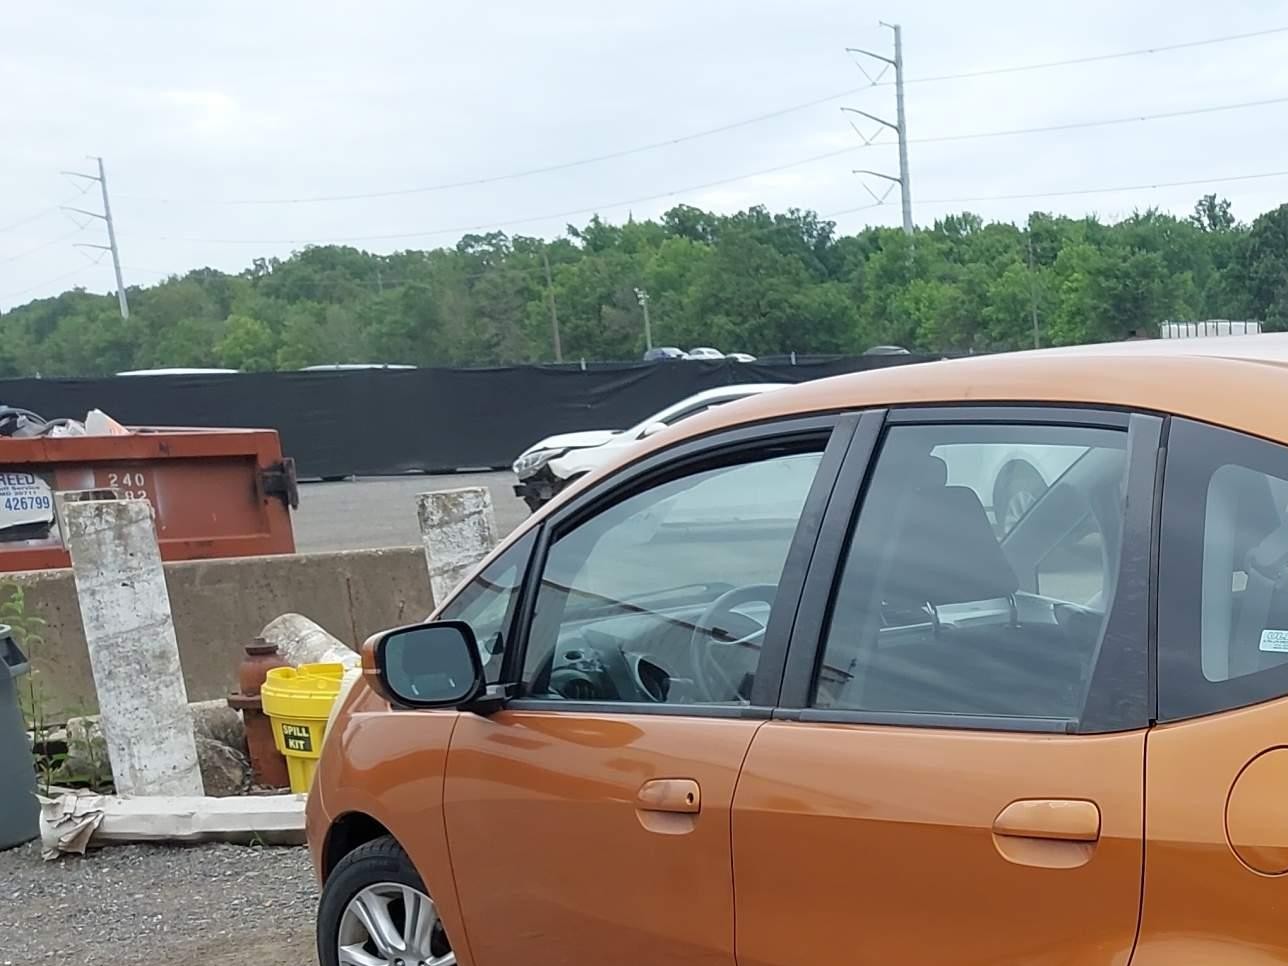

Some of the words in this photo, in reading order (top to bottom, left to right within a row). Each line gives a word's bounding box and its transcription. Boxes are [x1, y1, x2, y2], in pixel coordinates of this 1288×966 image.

[108, 472, 145, 487] 240
[5, 496, 50, 511] 426799
[283, 724, 309, 737] SPILL
[288, 738, 305, 750] KIT
